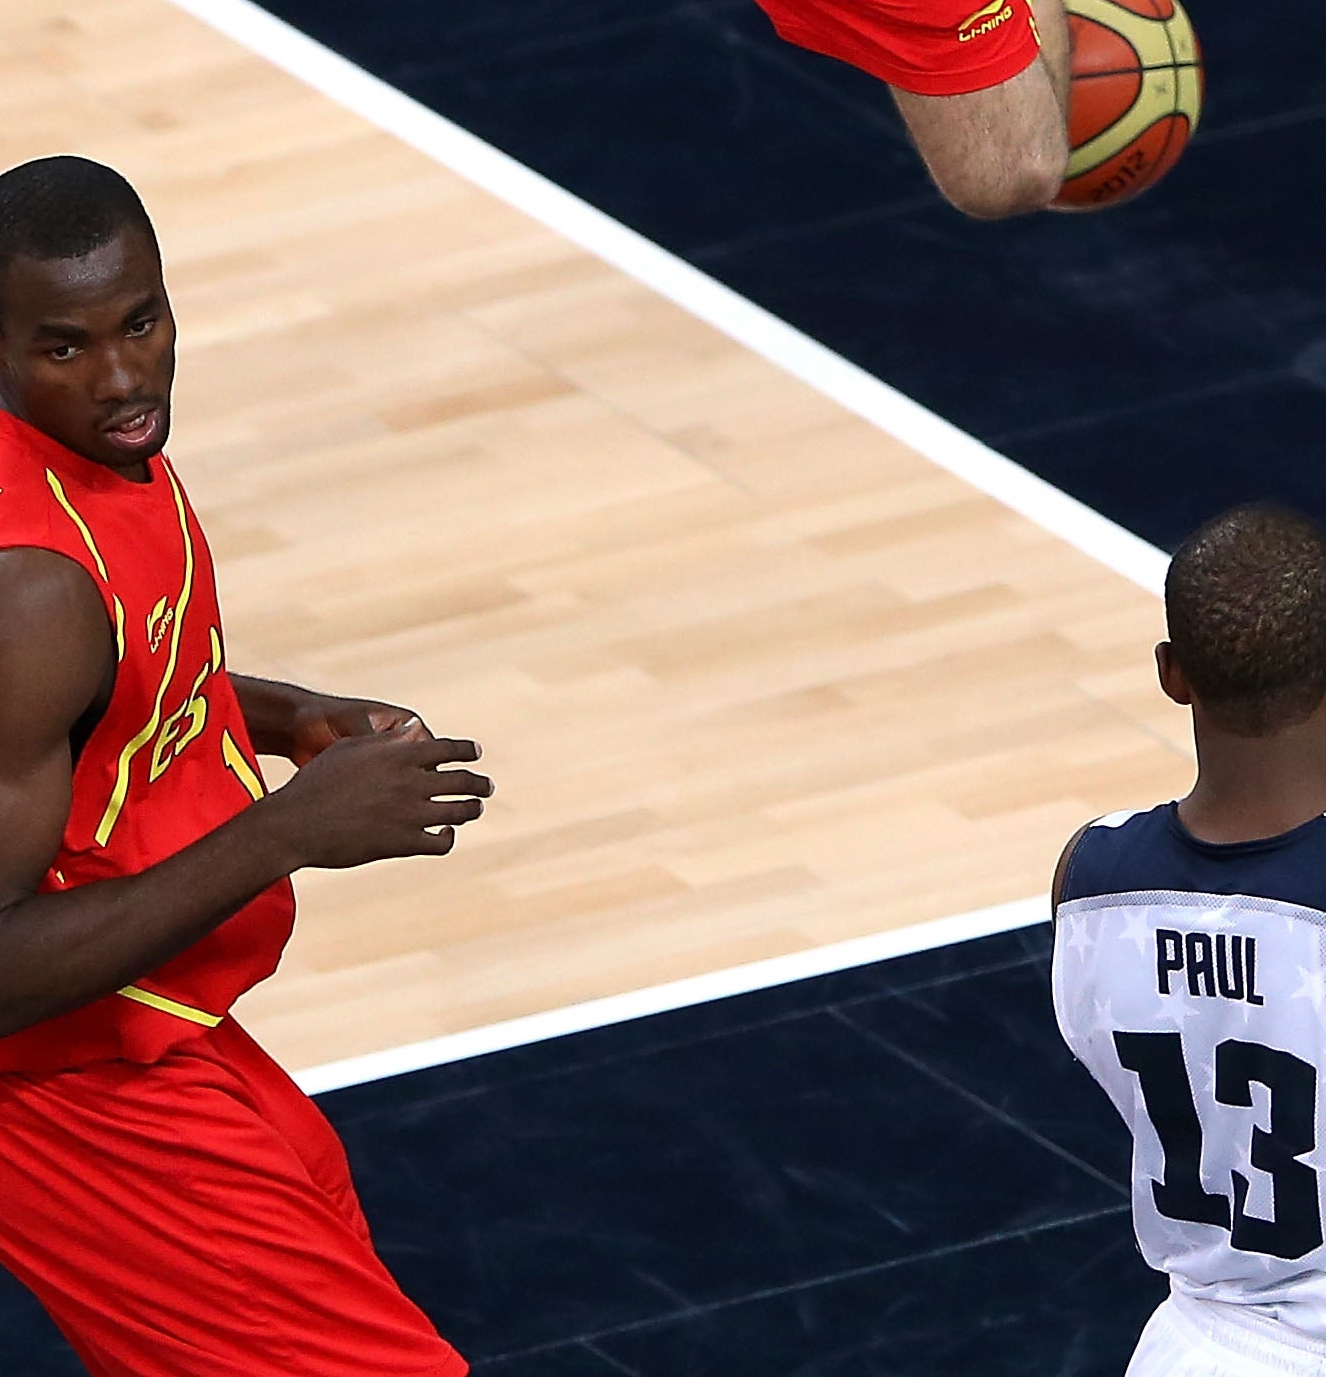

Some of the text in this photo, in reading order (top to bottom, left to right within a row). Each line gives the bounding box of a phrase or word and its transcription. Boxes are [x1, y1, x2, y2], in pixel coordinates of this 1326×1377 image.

[959, 6, 1013, 41] LI-NING
[1155, 927, 1264, 1006] PAUL
[1111, 1030, 1323, 1259] 13
